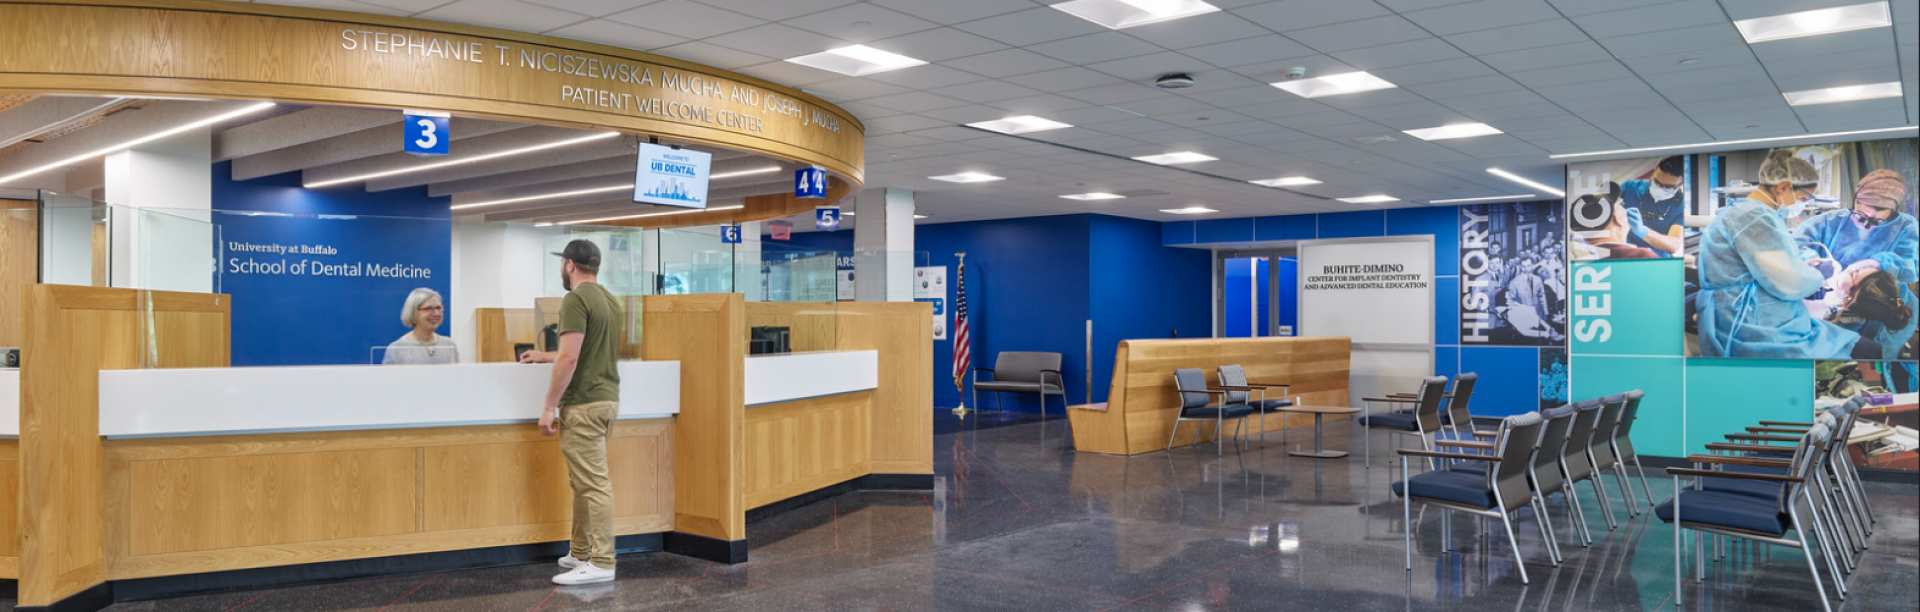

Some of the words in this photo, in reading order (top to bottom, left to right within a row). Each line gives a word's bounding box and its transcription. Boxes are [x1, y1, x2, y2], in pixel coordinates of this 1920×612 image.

[341, 29, 483, 63] STEPHANIE
[495, 44, 510, 67] T.
[520, 48, 654, 87] NICISZEWSKA
[660, 71, 723, 99] MUCHA
[729, 85, 759, 107] AND
[762, 92, 802, 119] JOSEPH
[812, 112, 840, 133] MUCHA
[562, 85, 631, 111] PATIENT
[636, 98, 713, 123] WELCOME
[717, 109, 764, 133] CENTER
[415, 118, 438, 149] 3
[663, 153, 683, 162] WELCOME
[650, 161, 664, 172] UB
[664, 163, 696, 177] DENTAL
[798, 170, 809, 193] 4
[815, 170, 824, 194] 4
[821, 210, 834, 227] 5
[726, 226, 738, 242] 6
[229, 241, 287, 256] University
[288, 245, 299, 254] at
[301, 245, 337, 256] Buffalo
[1573, 171, 1612, 343] SERVICE
[229, 257, 286, 275] School
[290, 259, 308, 275] of
[311, 261, 362, 277] Dental
[366, 263, 432, 279] Medicine
[1323, 263, 1404, 275] BUHITE-DIMINO
[1462, 207, 1489, 342] HISTORY
[1320, 282, 1357, 290] ADVANCED
[1385, 281, 1427, 289] EDUCATION
[1349, 274, 1380, 282] IMPLANT
